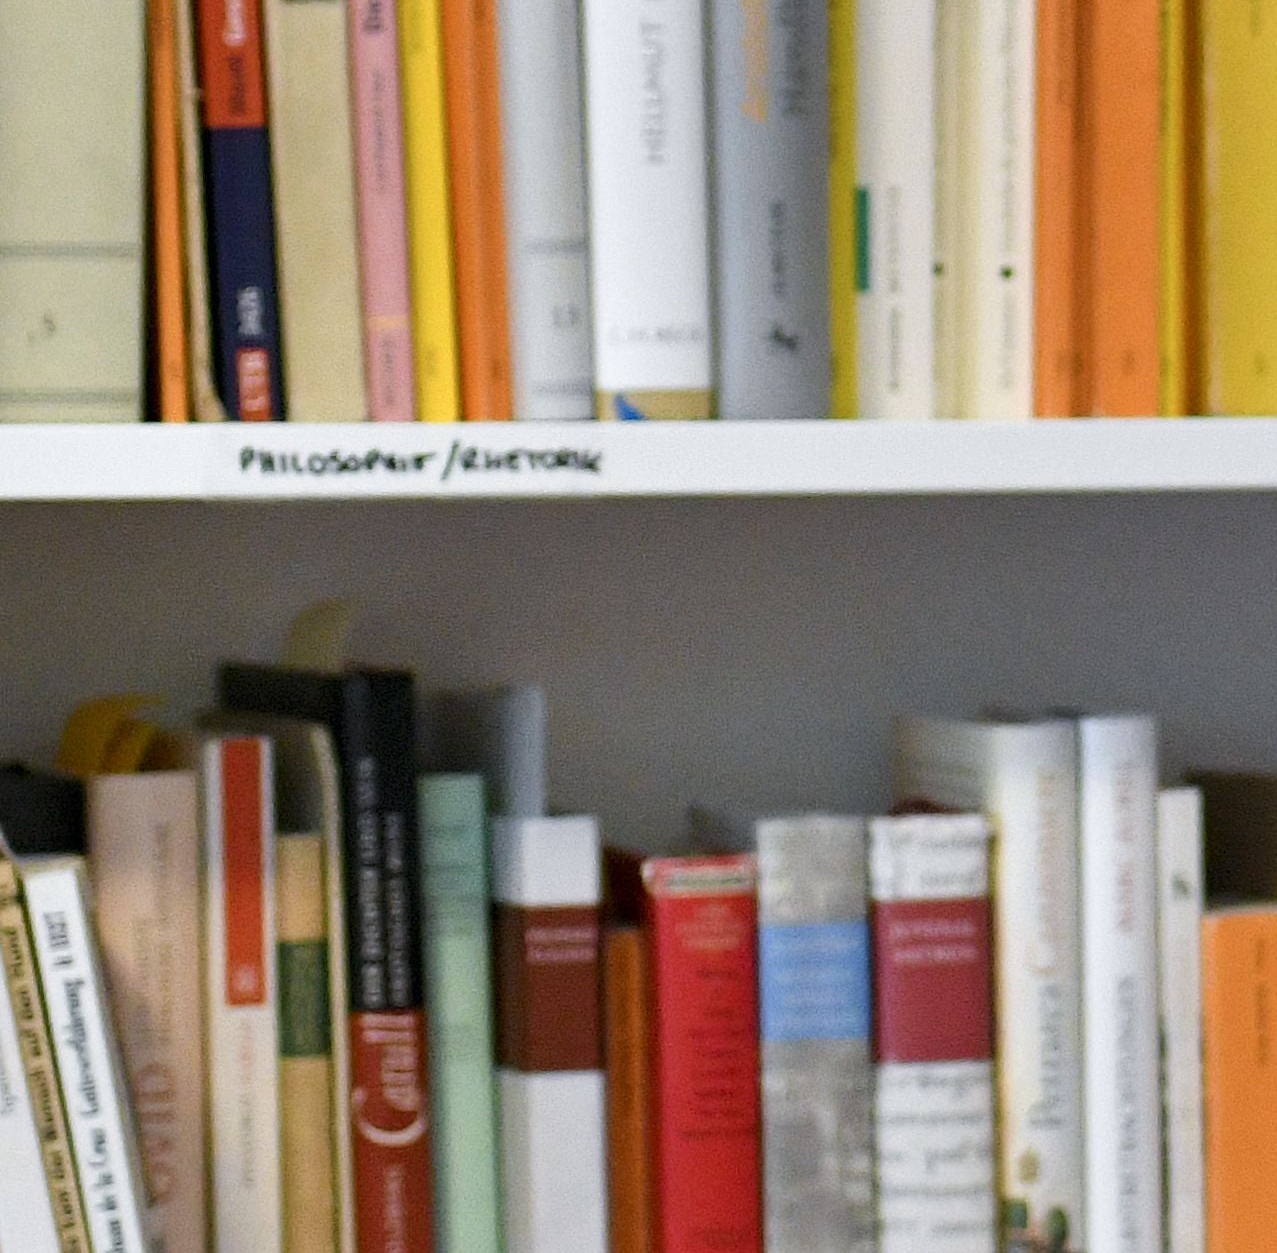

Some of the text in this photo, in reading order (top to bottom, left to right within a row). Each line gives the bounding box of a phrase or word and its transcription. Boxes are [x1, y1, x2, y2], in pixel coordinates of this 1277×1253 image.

[638, 22, 668, 167] HELLMUT
[239, 353, 268, 412] UTB
[352, 1011, 427, 1147] Catull
[1029, 980, 1066, 1130] Petrarca
